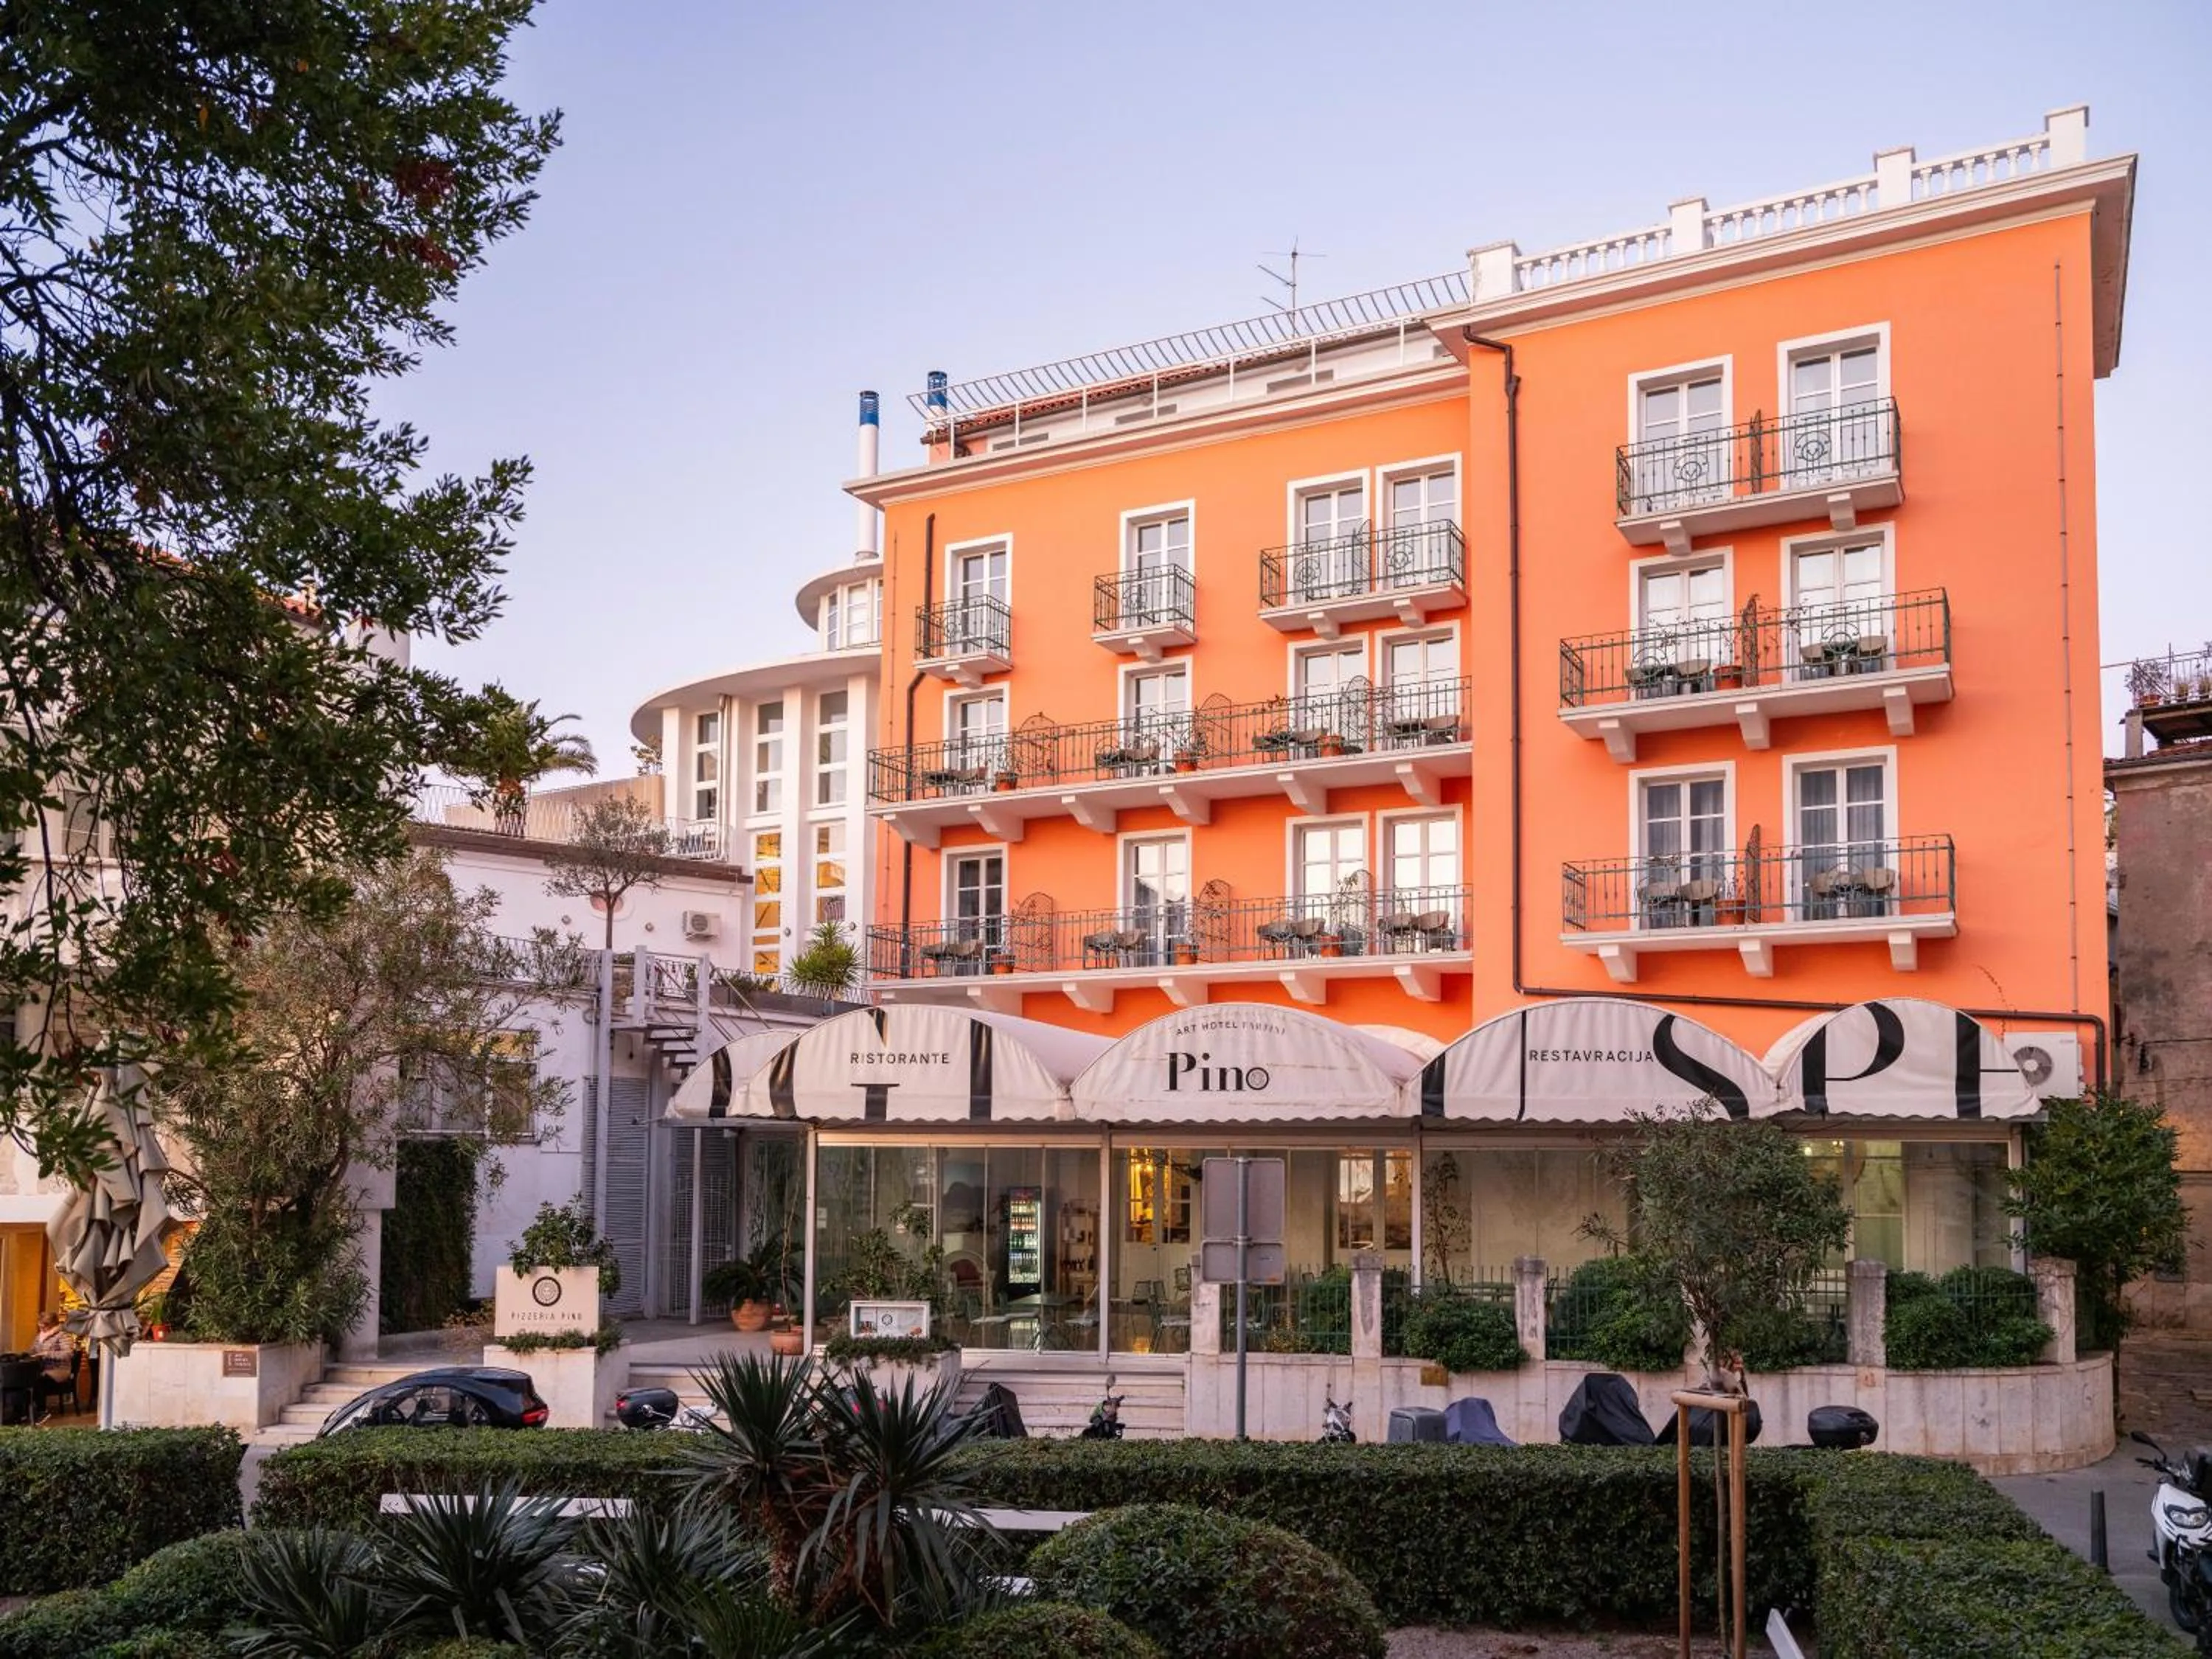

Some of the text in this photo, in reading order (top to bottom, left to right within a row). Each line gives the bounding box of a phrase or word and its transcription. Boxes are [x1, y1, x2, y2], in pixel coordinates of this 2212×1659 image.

[1176, 1023, 1197, 1036] ART
[1202, 1021, 1238, 1030] HOTEL
[850, 1052, 950, 1065] RISTORANTE
[1528, 1048, 1655, 1063] RESTAVRACIJA
[1164, 1052, 1270, 1092] Pino
[511, 1312, 582, 1321] PIZZERIA PINO
